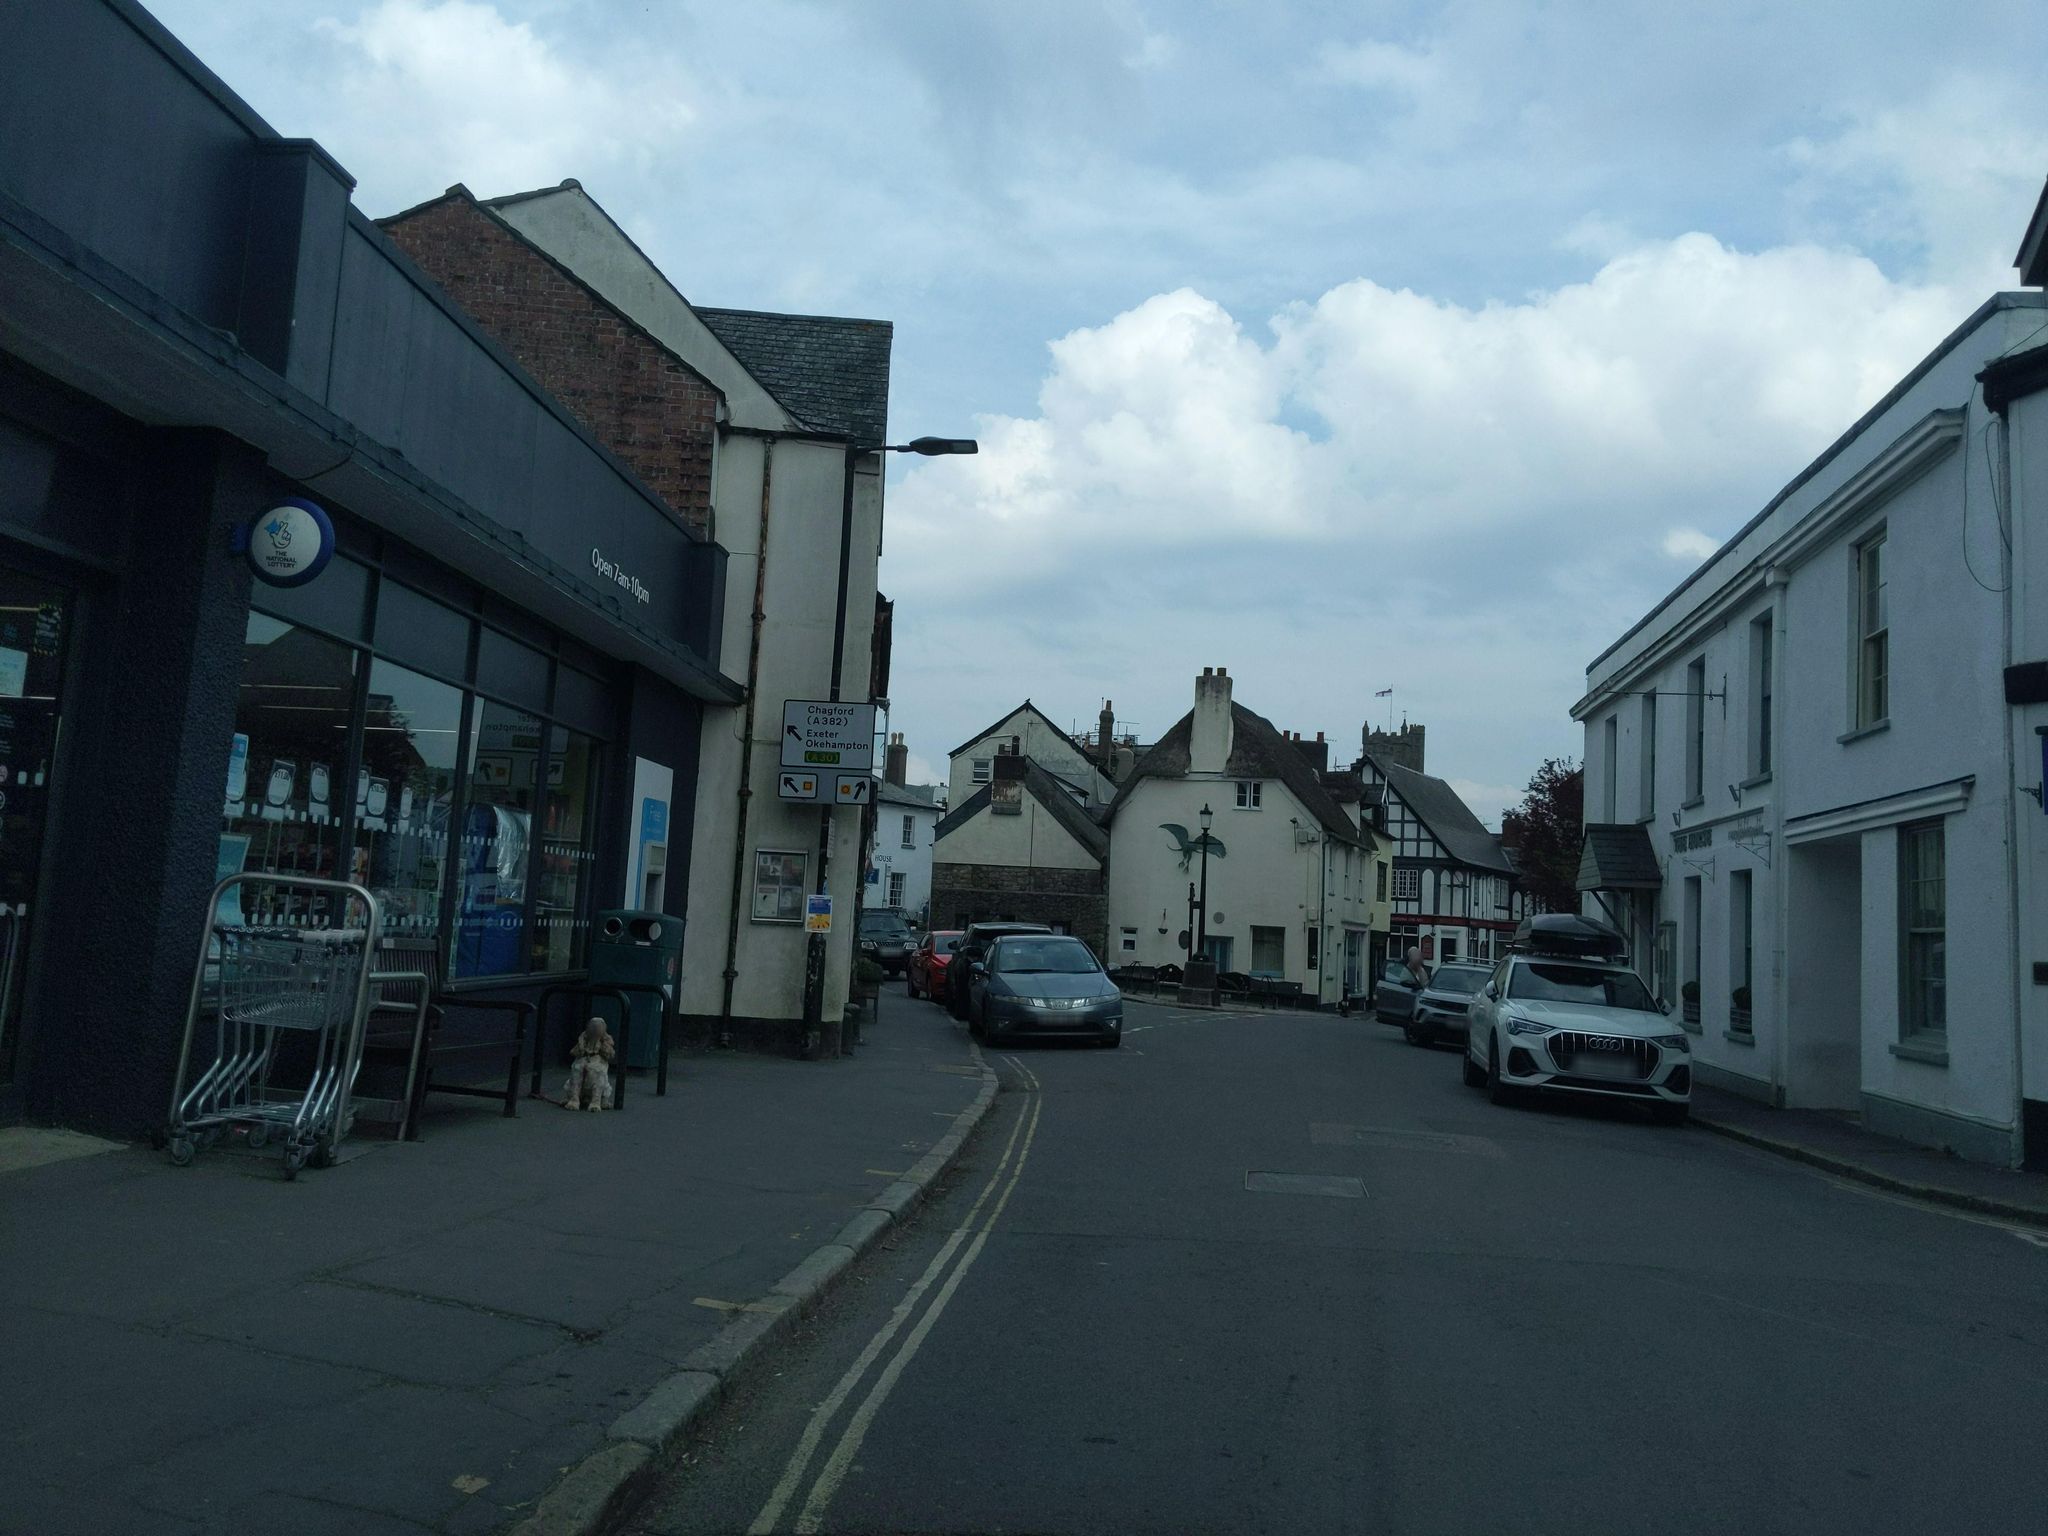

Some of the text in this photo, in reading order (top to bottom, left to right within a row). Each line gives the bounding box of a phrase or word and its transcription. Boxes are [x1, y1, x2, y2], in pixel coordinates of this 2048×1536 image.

[592, 548, 650, 604] Open 7am-10pm
[808, 705, 854, 716] Chagford
[807, 716, 848, 727] (A382)
[806, 729, 839, 739] Exeter
[805, 739, 869, 751] Okehampton
[806, 752, 839, 763] (A30)
[875, 854, 892, 862] HOUSE
